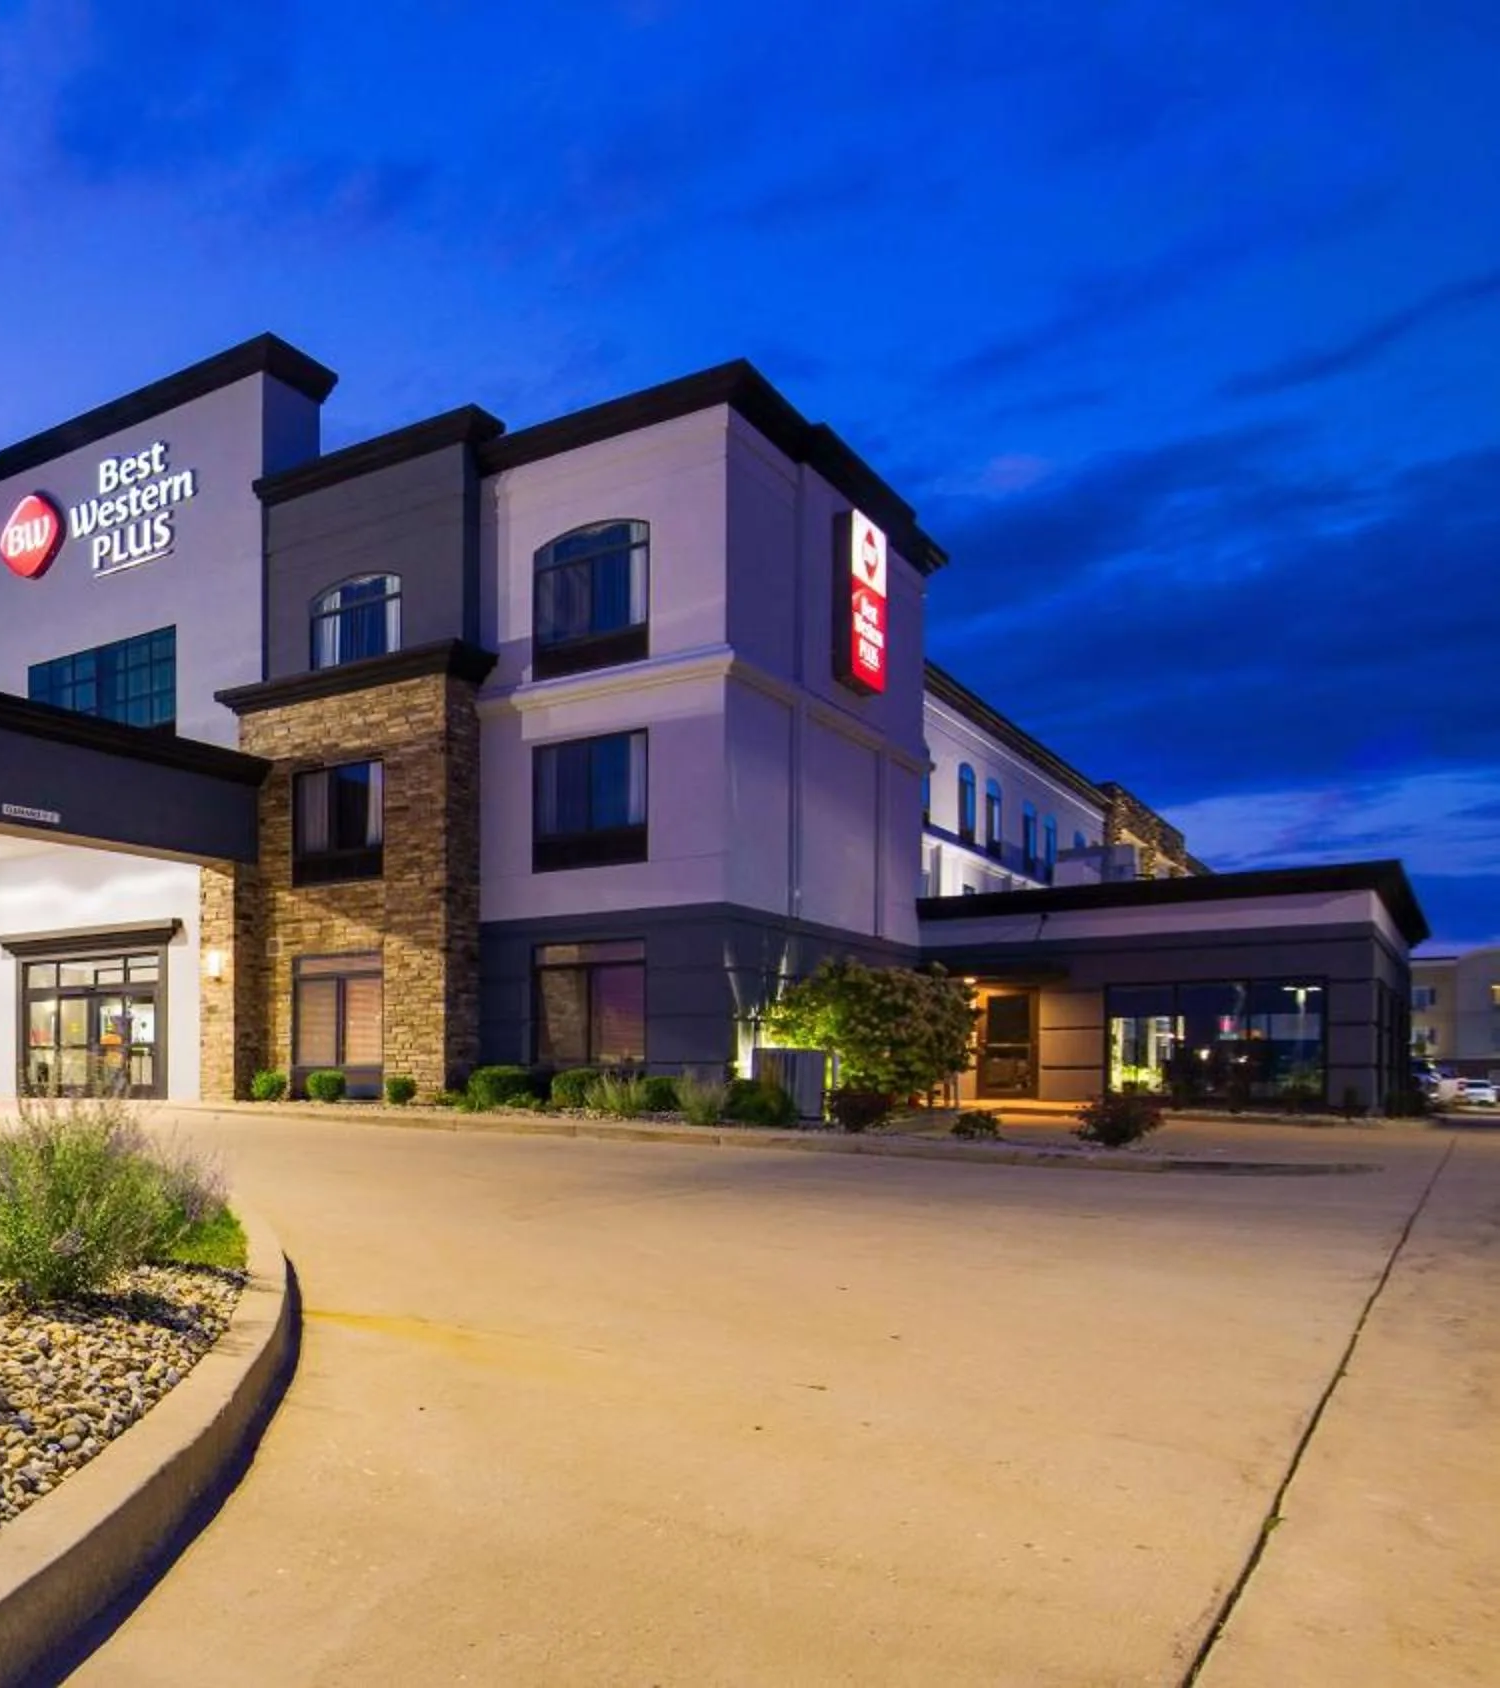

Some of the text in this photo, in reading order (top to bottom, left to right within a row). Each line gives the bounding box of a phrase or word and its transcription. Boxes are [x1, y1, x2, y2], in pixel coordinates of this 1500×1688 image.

[99, 441, 166, 494] Best
[70, 469, 193, 539] Western
[7, 514, 50, 557] BW
[92, 511, 172, 569] PLUS
